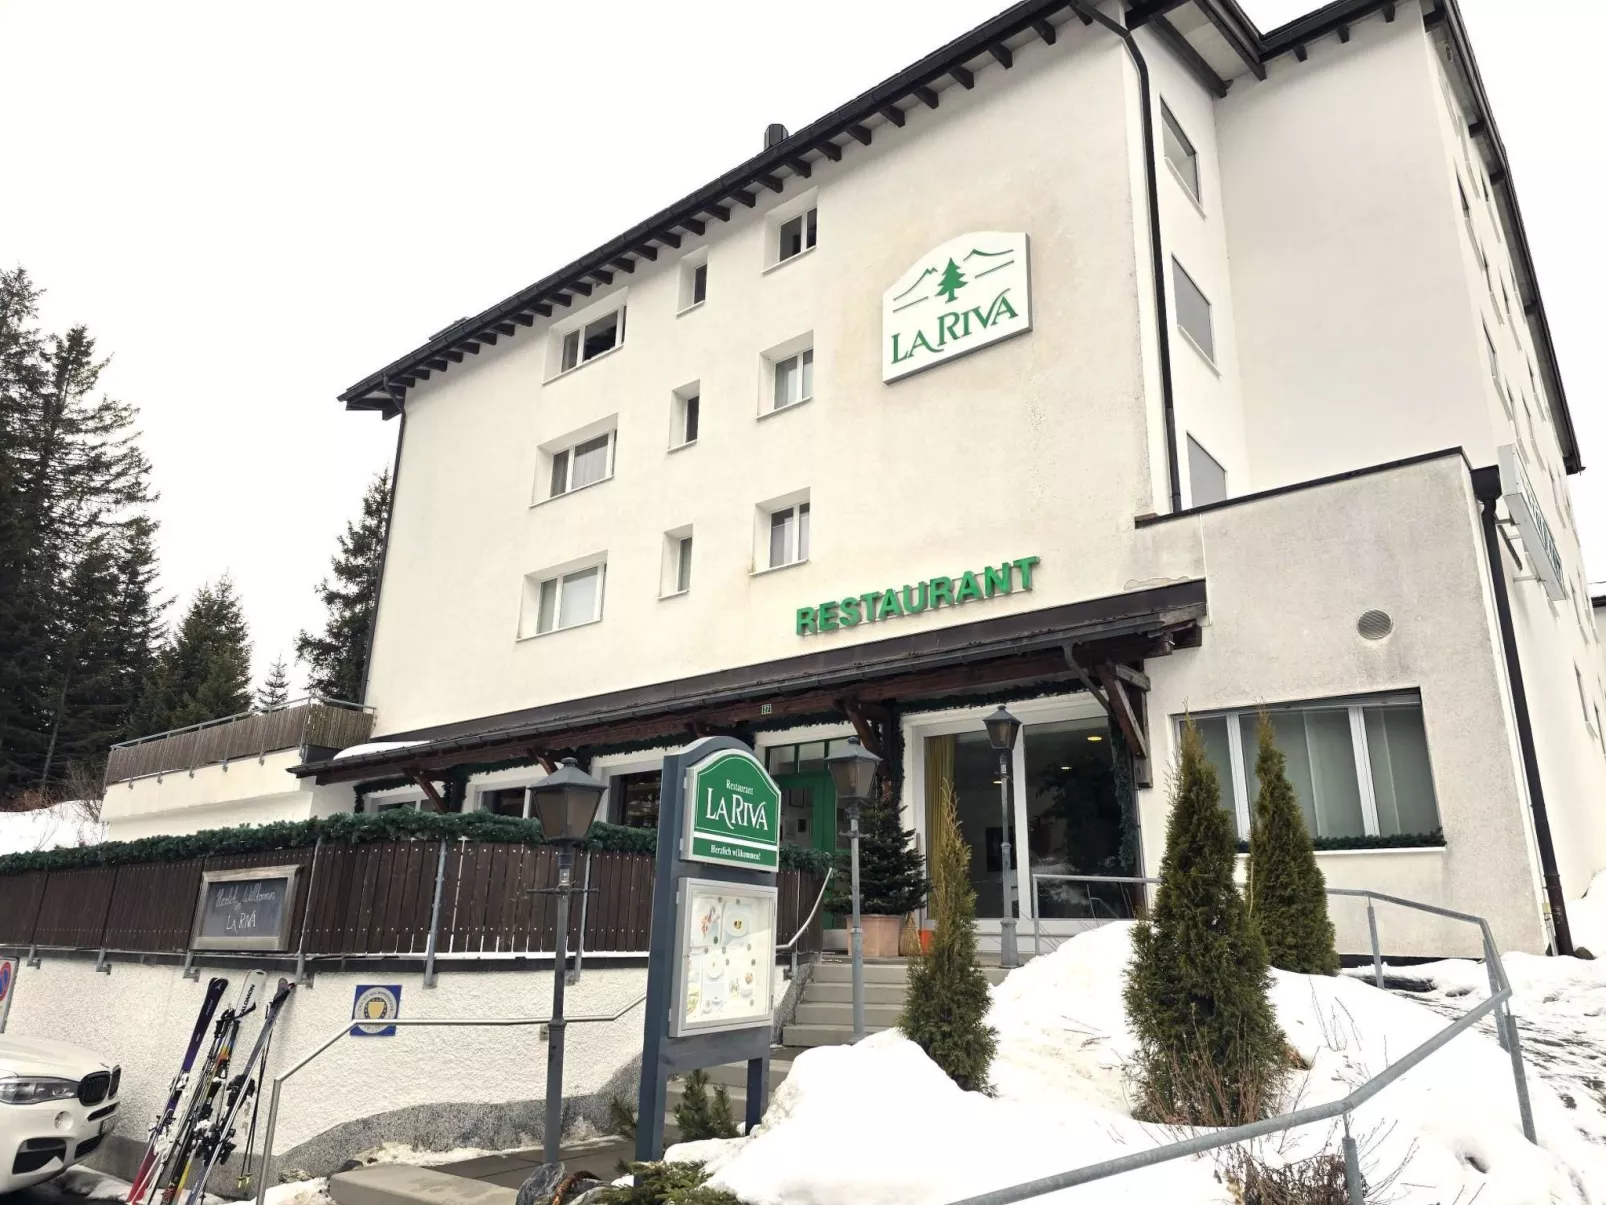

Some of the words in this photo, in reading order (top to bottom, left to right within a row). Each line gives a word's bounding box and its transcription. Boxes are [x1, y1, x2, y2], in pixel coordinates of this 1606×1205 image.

[891, 330, 944, 364] LA
[937, 288, 1019, 347] RIVA
[796, 555, 1041, 637] RESTAURANT
[726, 779, 754, 795] Restaurant
[706, 787, 735, 830] LA
[731, 793, 769, 831] RIVA
[710, 844, 732, 856] Herzlich
[240, 984, 256, 1015] ALOMON
